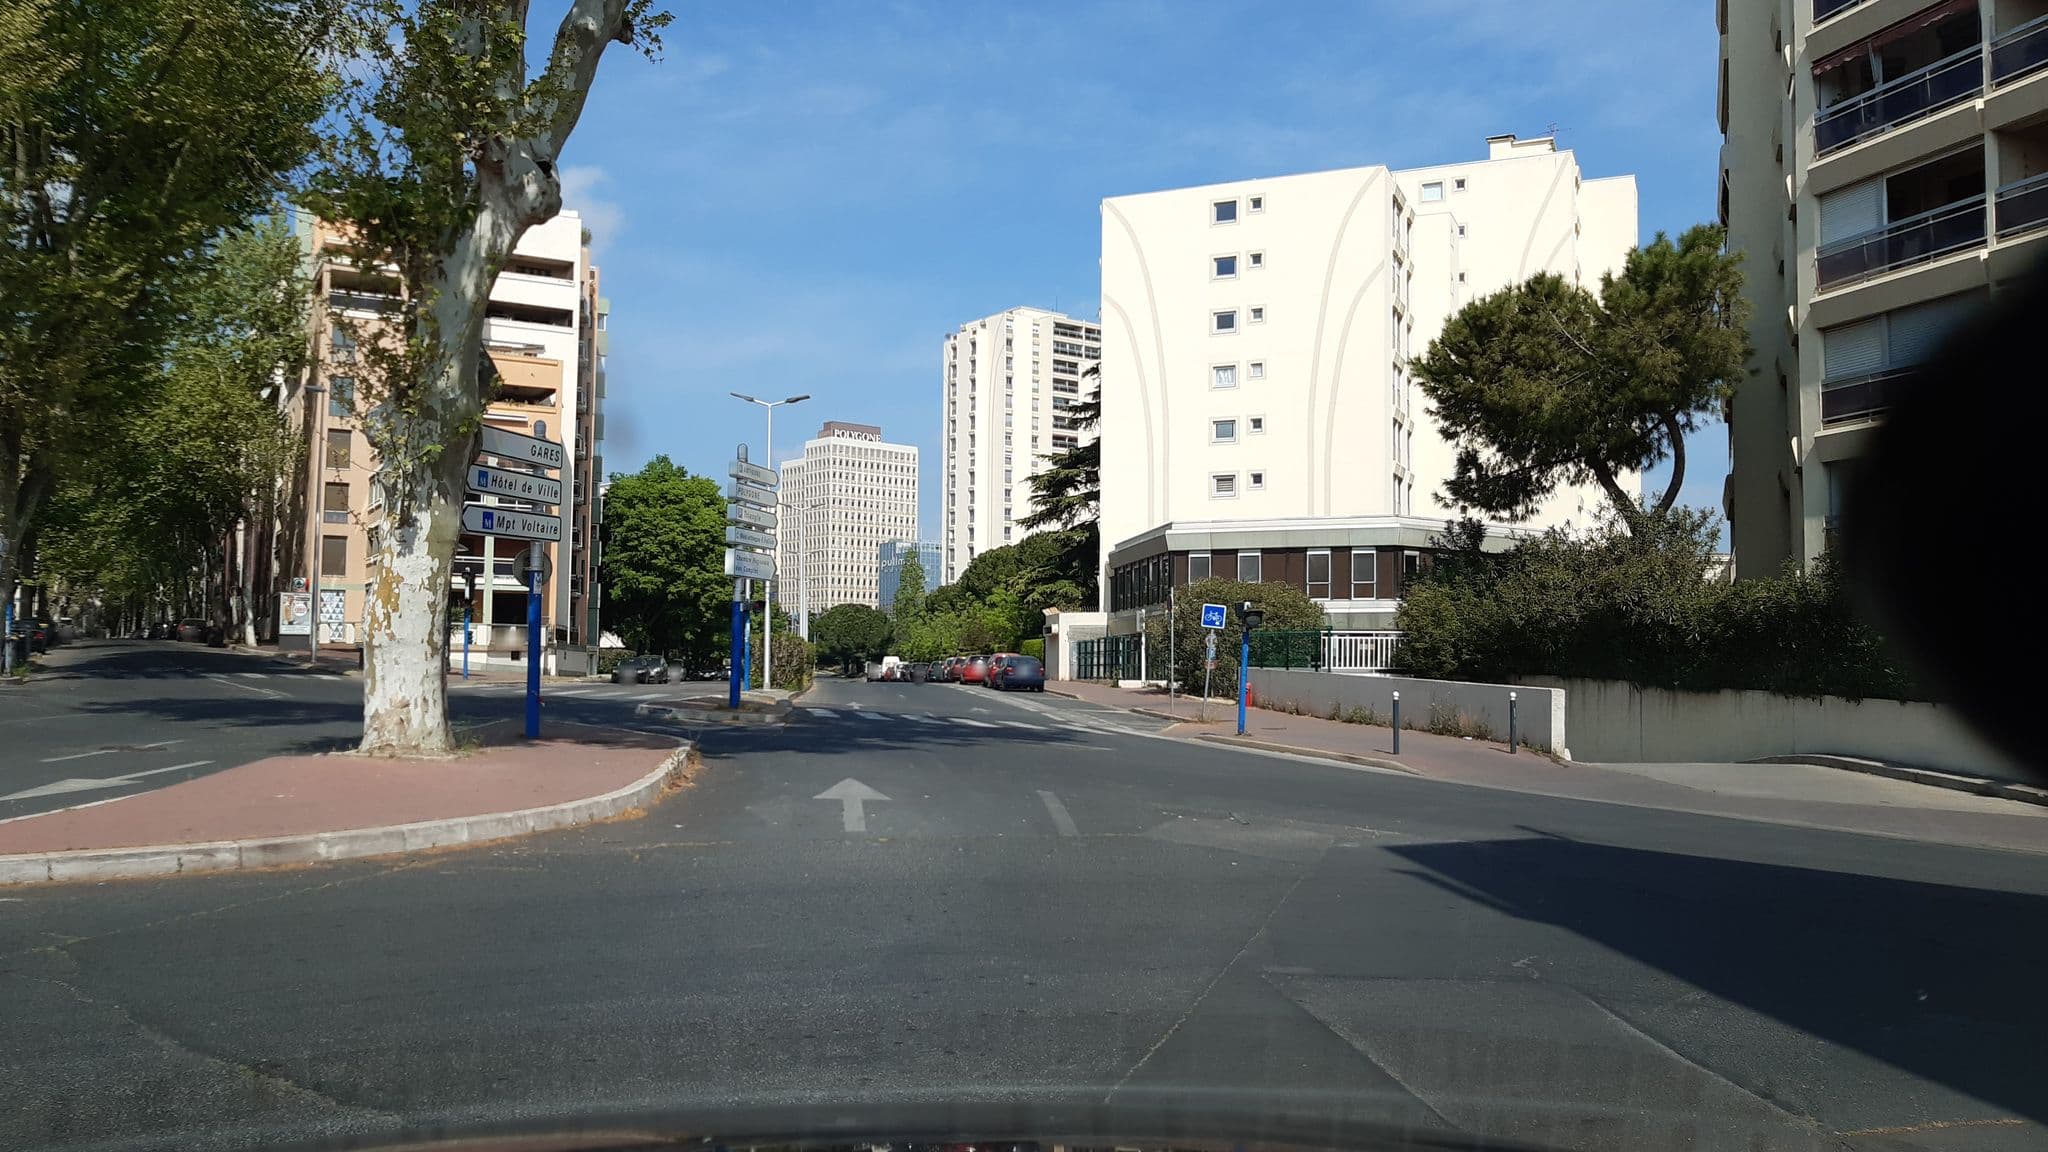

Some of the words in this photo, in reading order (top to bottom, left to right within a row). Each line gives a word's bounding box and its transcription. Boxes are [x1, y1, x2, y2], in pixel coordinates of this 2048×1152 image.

[834, 428, 881, 442] POLYGONE
[530, 445, 560, 462] GARES
[491, 475, 517, 491] Hôtel
[521, 480, 532, 494] de
[538, 483, 559, 498] Ville
[496, 516, 516, 530] Mpt
[521, 519, 559, 535] Voltaire
